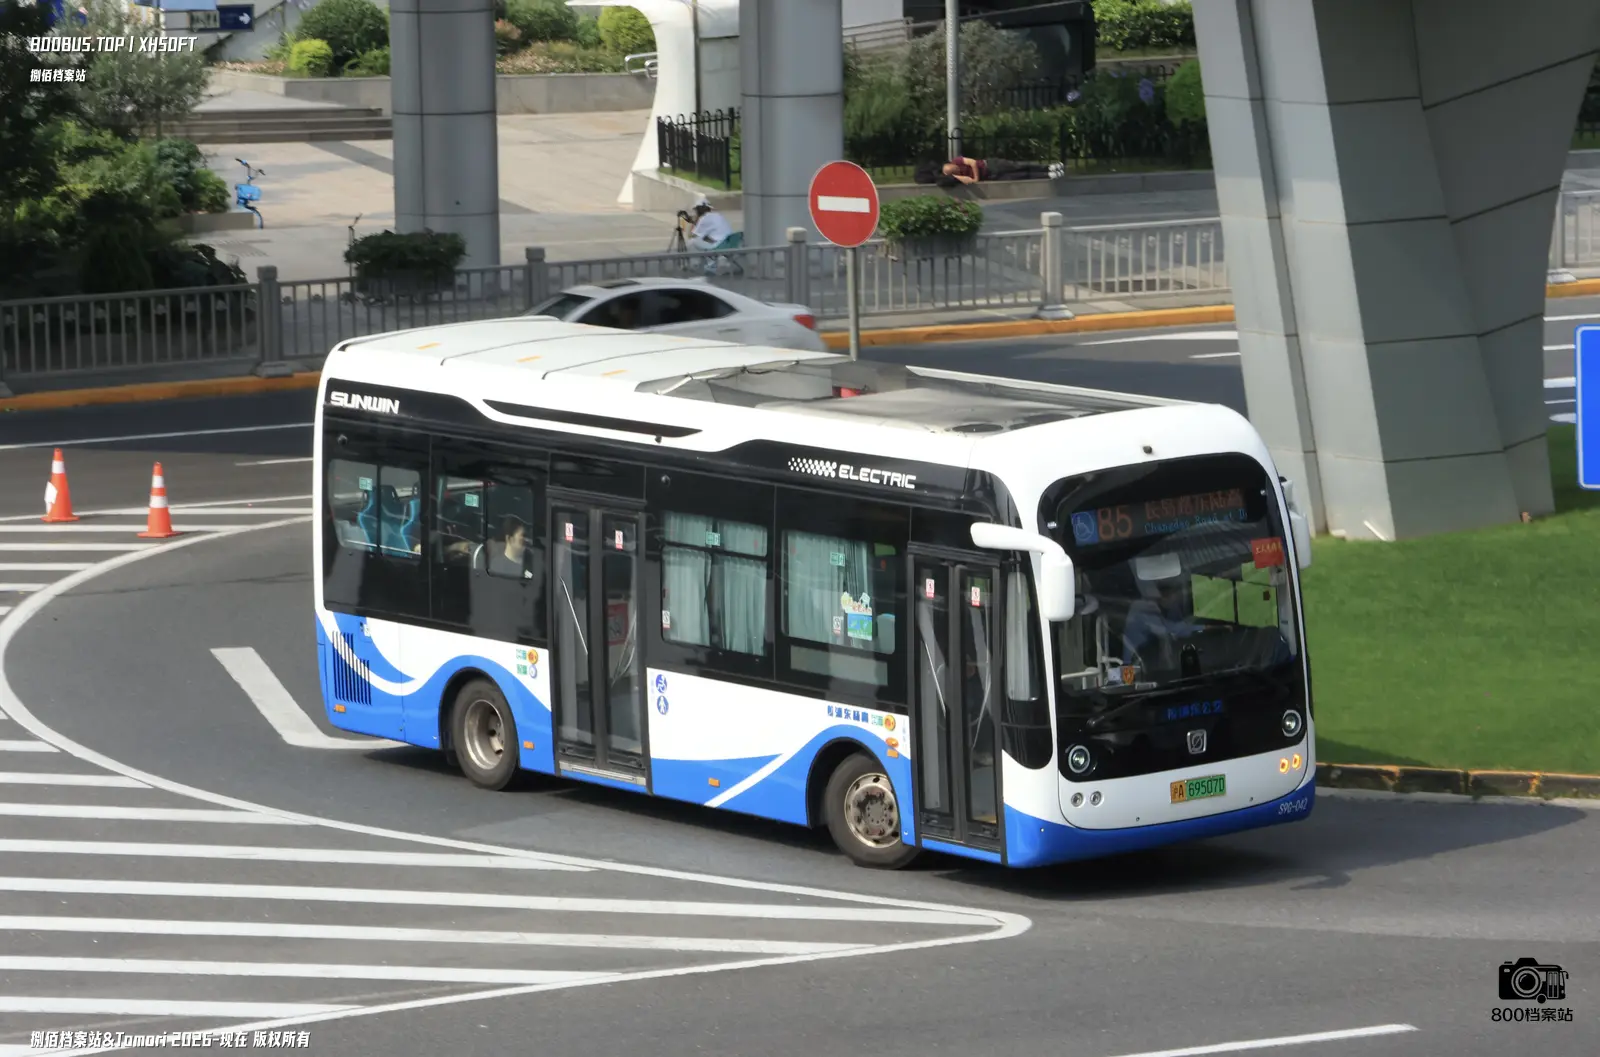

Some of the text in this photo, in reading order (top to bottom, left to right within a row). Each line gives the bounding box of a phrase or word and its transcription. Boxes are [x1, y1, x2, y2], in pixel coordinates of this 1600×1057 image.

[330, 390, 400, 414] SUNWIN
[838, 463, 917, 489] ELECTRIC
[1097, 505, 1133, 540] 85
